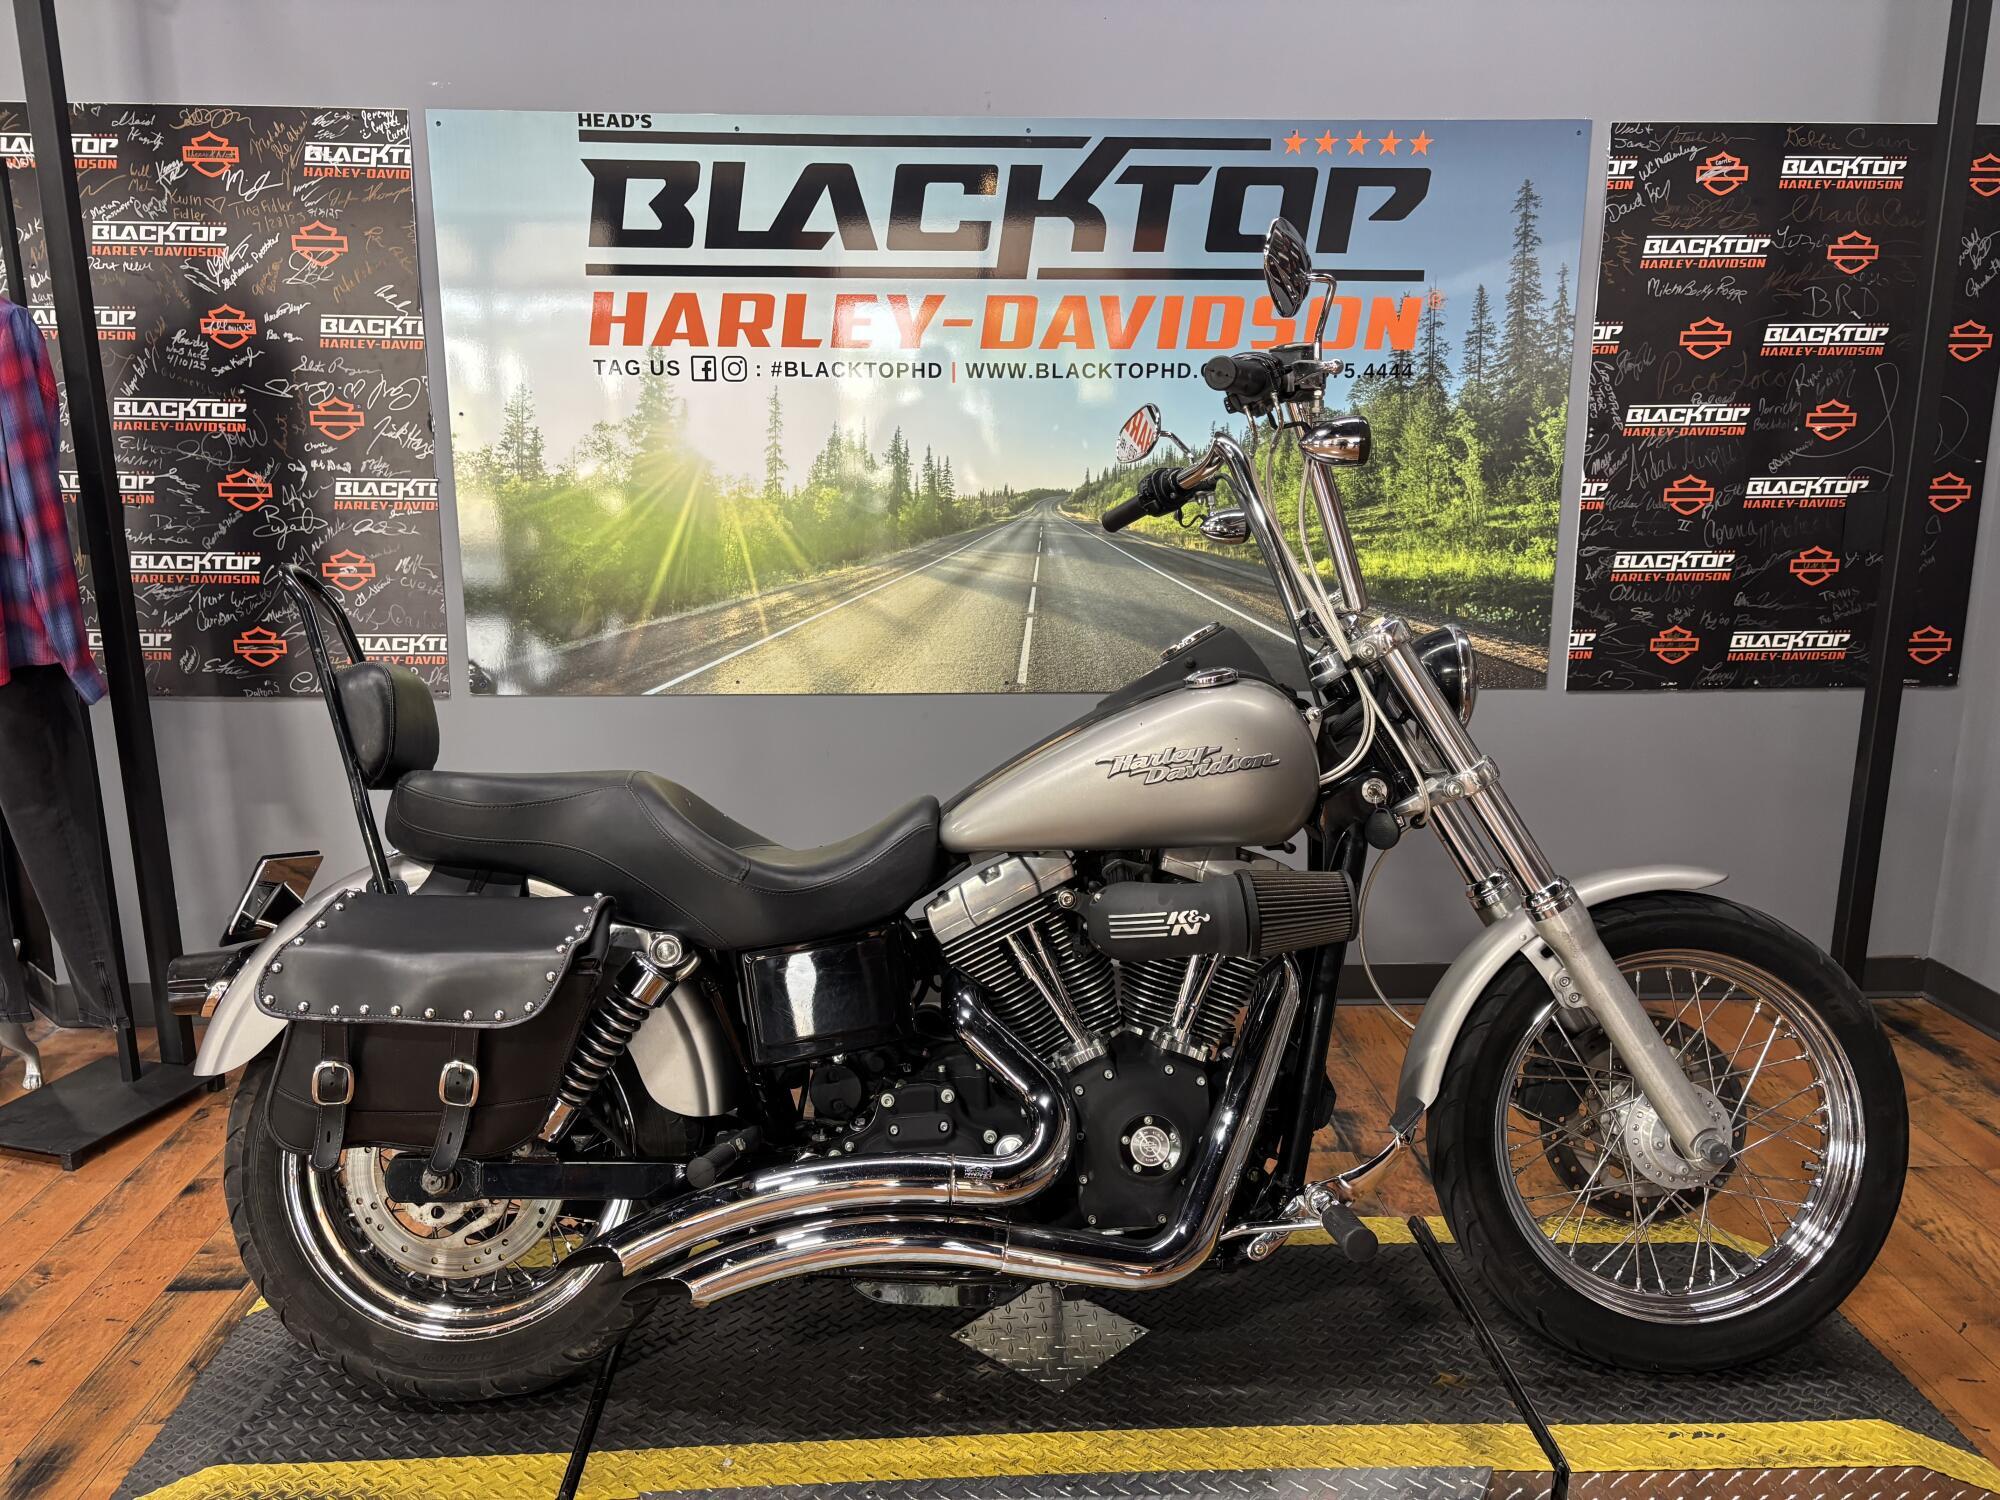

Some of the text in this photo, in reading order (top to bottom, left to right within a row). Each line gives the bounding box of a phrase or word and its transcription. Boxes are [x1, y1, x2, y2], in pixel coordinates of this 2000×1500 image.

[578, 113, 652, 129] HEAD'S
[1781, 157, 1907, 178] BLACKTOP
[1778, 179, 1904, 190] HARLEY-DAVIDSON
[580, 137, 1432, 279] BLACKTOP
[92, 222, 228, 245] BLACKTOP
[92, 245, 227, 257] HARLEY-DAVIDSON
[1643, 234, 1772, 257] BLACKTOP
[1639, 258, 1767, 269] HARLEY-DAVIDSON
[588, 291, 1423, 350] HARLEY-DAVIDSON
[1764, 323, 1890, 345] BLACKTOP
[1760, 346, 1884, 357] HARLEY-DAVIDSON
[593, 359, 640, 376] TAG
[650, 360, 680, 376] US
[771, 361, 943, 379] #BLACKTOPHD
[965, 362, 1206, 380] WWW.BLACKTOPHD.
[1332, 363, 1414, 379] 5.4444
[113, 399, 247, 421] BLACKTOP
[1625, 404, 1751, 426] BLACKTOP
[113, 421, 247, 433] HARLEY-DAVIDSON
[1622, 426, 1747, 437] HARLEY-DAVIDSON
[1744, 477, 1870, 498] BLACKTOP
[334, 500, 439, 511] HARLEY-DAVID
[1742, 498, 1847, 509] HARLEY-DAVIDS
[130, 552, 261, 574] BLACKTOP
[1613, 549, 1736, 570] BLACKTOP
[130, 574, 260, 585] HARLEY-DAVIDSON
[1610, 571, 1732, 582] HARLEY-DAVIDSON
[359, 634, 447, 655] LACKT
[1730, 631, 1851, 650] BLACKTOP
[1726, 651, 1846, 662] HARLEY-DAVIDSON
[1143, 753, 1281, 786] Davidson
